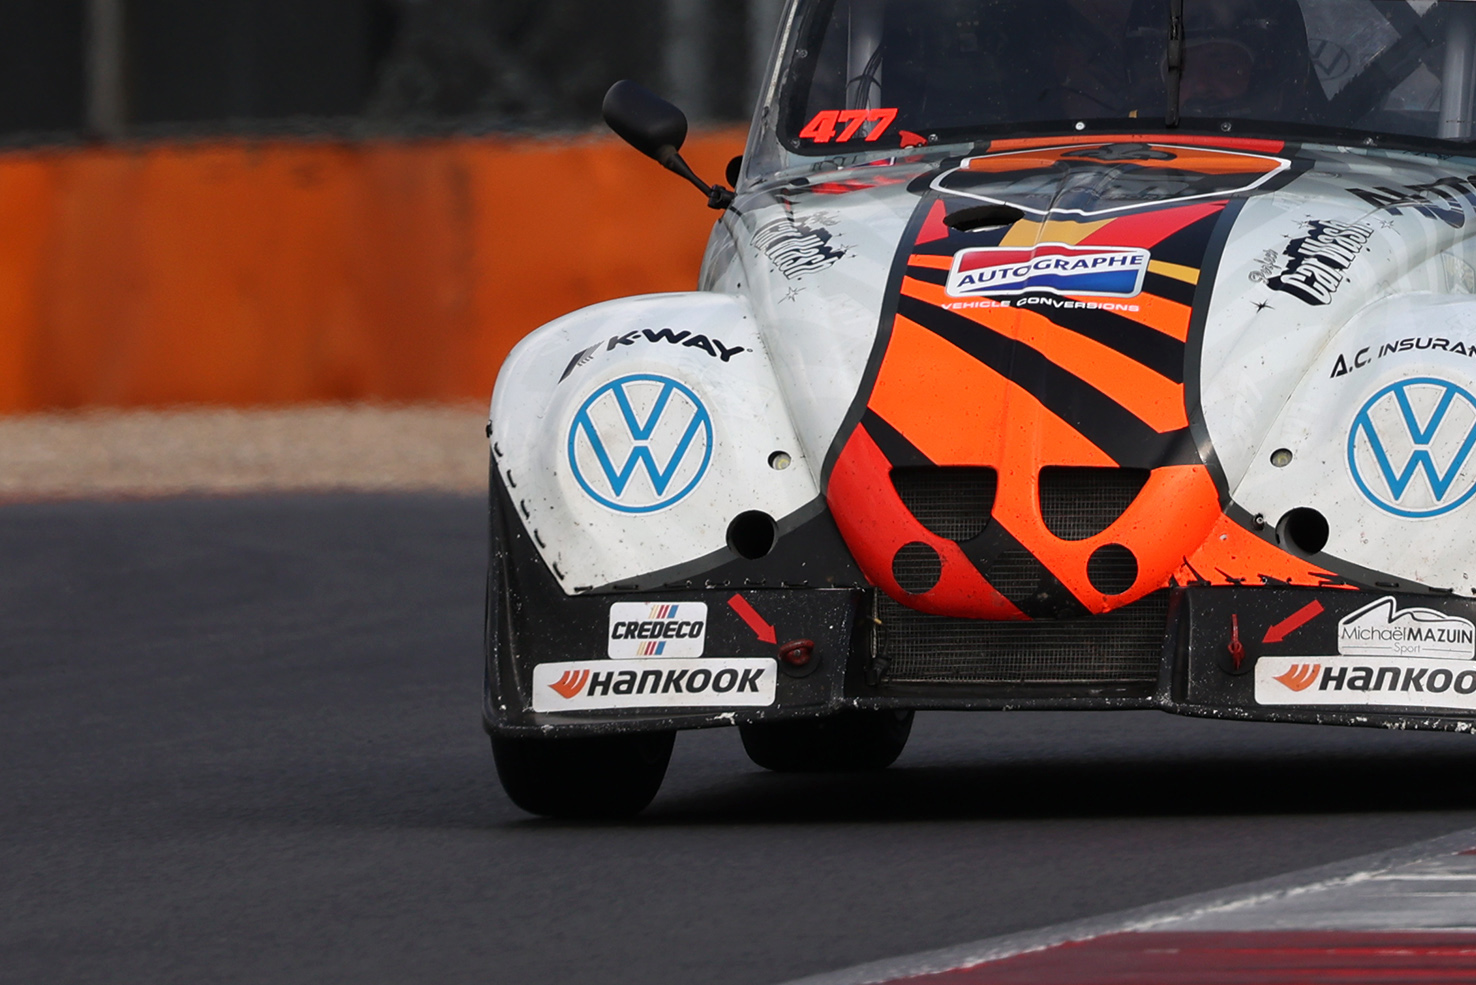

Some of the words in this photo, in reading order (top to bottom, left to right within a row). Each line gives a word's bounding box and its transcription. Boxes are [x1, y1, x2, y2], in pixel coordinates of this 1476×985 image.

[798, 107, 899, 143] 477
[956, 254, 1145, 288] AUTOGRAPHE
[941, 299, 1011, 310] VEHICLE
[1016, 297, 1140, 312] CONVERSIONS
[606, 328, 745, 362] K-WAY
[1329, 346, 1373, 379] A.C.
[611, 619, 705, 641] CREDECO
[1393, 642, 1422, 656] Sport
